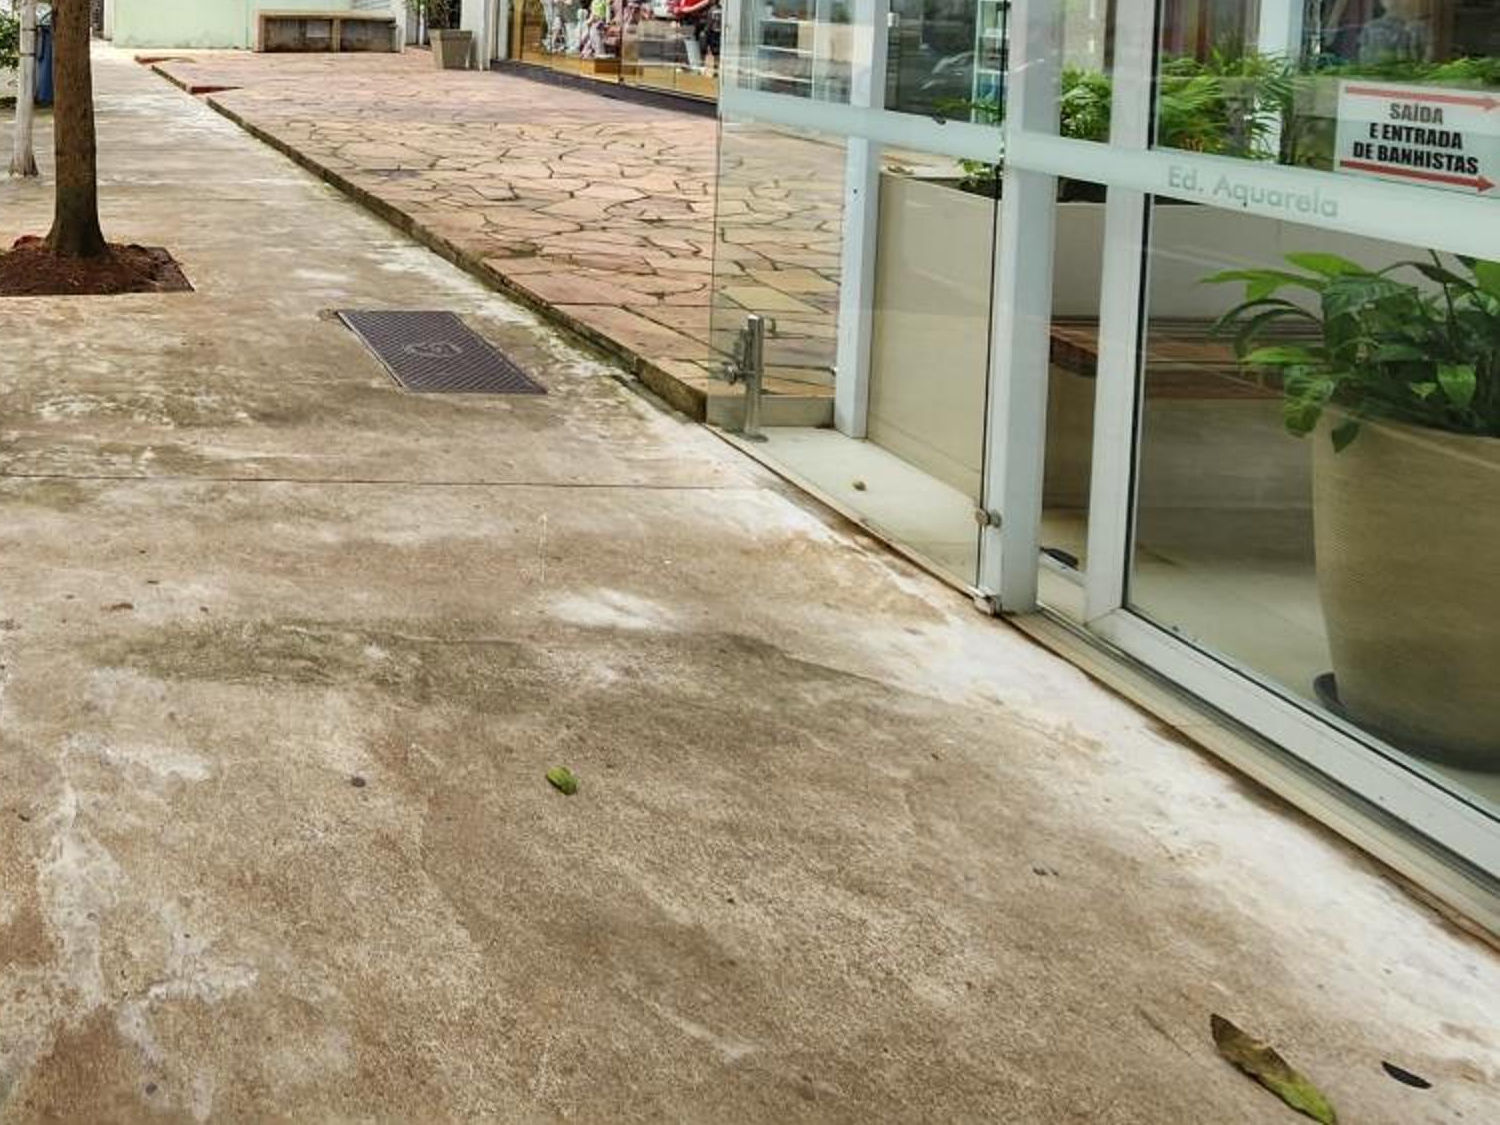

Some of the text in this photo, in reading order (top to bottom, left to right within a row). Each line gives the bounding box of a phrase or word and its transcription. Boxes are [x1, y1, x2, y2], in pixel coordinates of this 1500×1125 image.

[1389, 102, 1444, 125] SAÍDA
[1369, 122, 1463, 150] E ENTRADA
[1353, 141, 1478, 175] DE BANHISTAS
[1168, 165, 1339, 217] Ed. Aquarela
